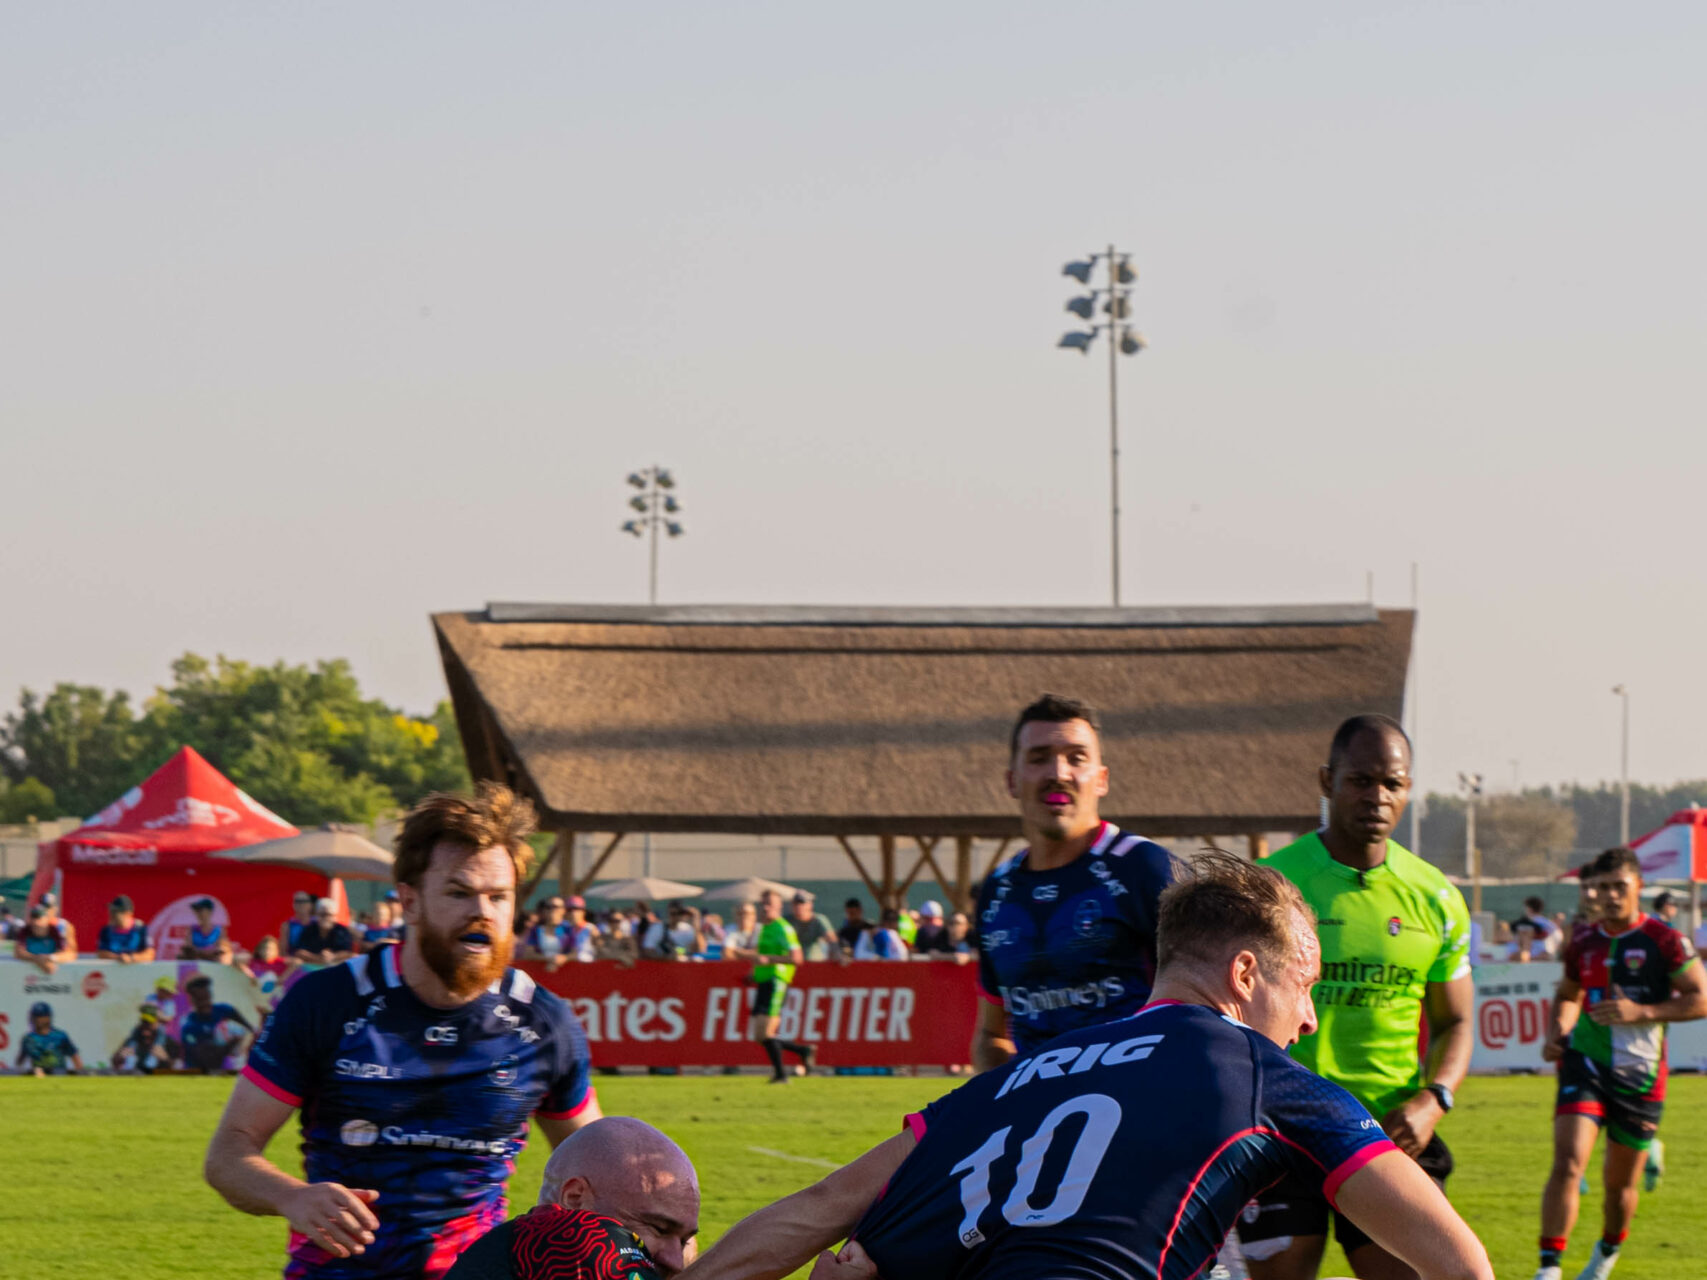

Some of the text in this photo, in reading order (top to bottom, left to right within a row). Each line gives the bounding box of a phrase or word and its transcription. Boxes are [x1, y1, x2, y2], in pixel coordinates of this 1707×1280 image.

[1321, 957, 1418, 986] mirates
[777, 986, 916, 1042] BETTER
[949, 1093, 1123, 1250] 10
